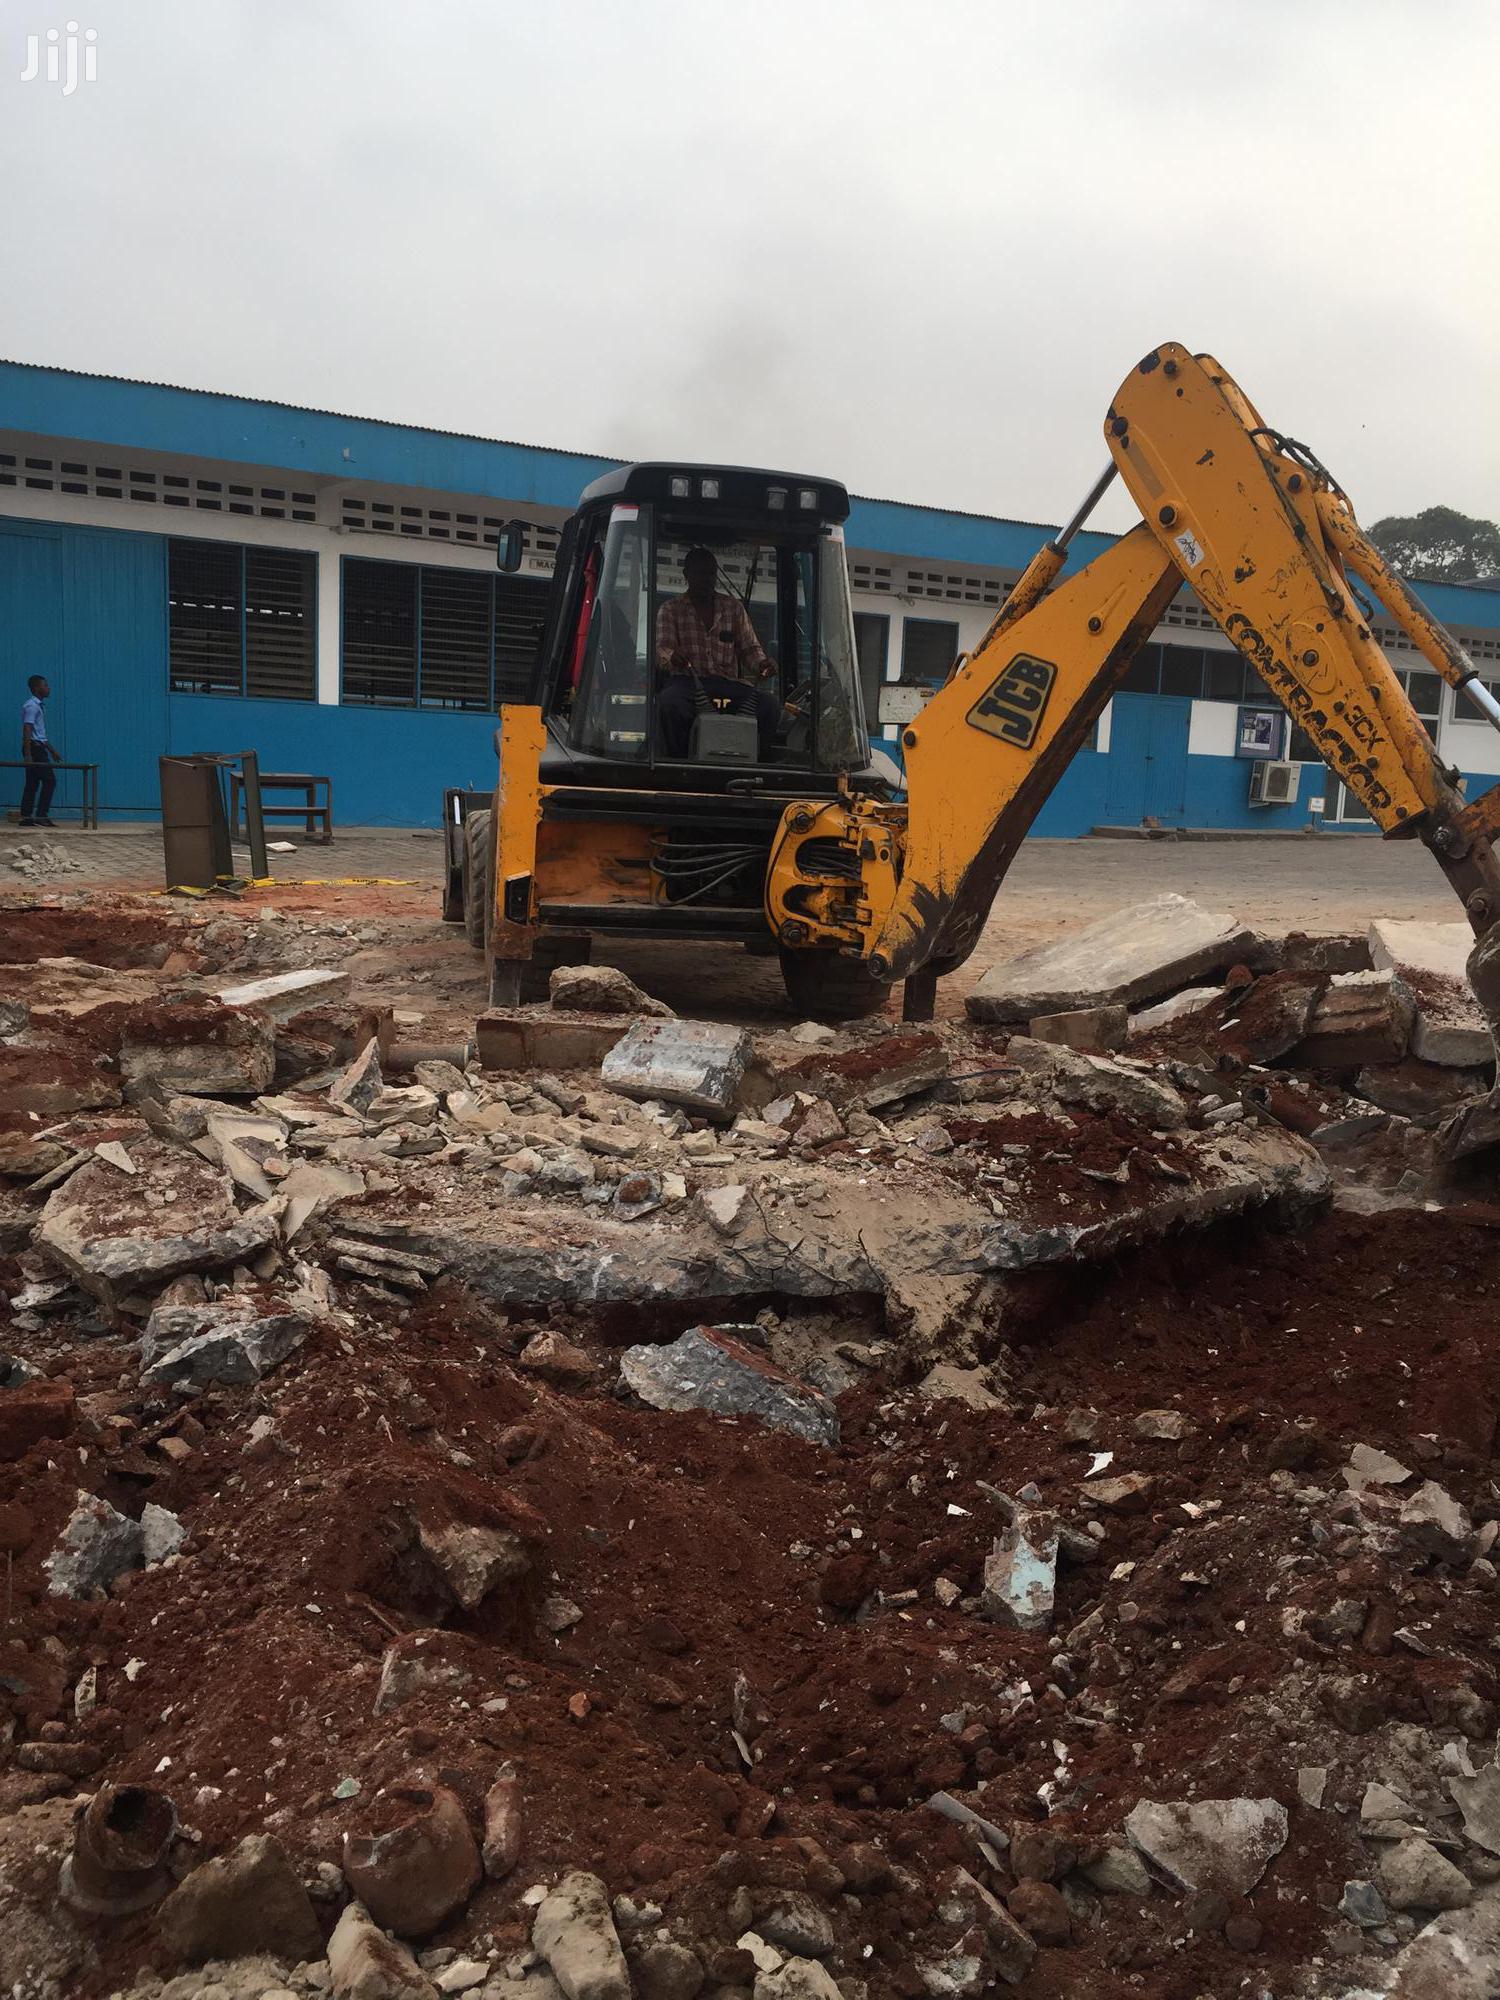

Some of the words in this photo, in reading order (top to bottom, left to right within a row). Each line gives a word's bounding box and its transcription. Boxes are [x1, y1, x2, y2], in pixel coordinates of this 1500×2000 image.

[976, 659, 1050, 742] JCB
[1225, 613, 1391, 811] CONTRACTOR
[1344, 705, 1386, 753] 3CX
